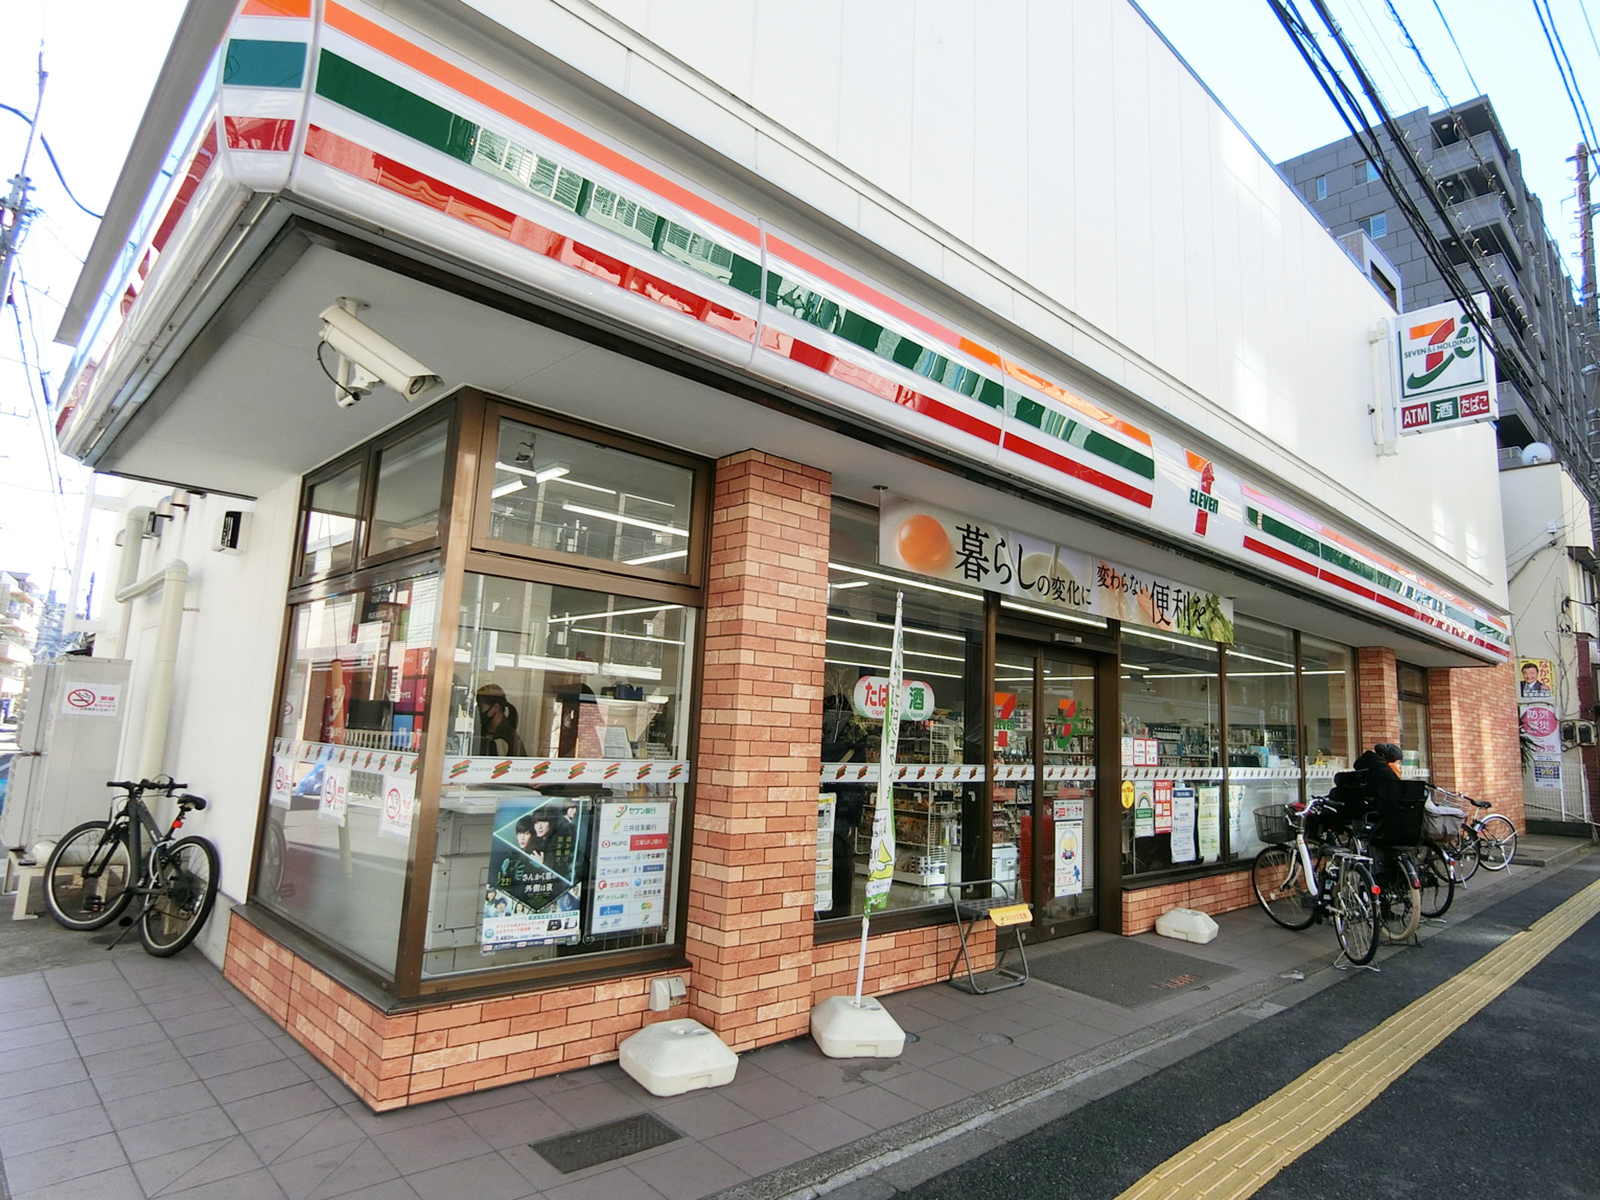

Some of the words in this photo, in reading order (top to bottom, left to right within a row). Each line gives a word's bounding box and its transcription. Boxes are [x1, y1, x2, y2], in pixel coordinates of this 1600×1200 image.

[1437, 337, 1477, 351] HOLDINGS
[1435, 401, 1454, 420] 酒
[1461, 394, 1489, 414] たばこ
[1403, 407, 1428, 425] ATM
[955, 523, 1092, 606] 暮らしの変化に
[1097, 565, 1207, 631] 変わらない便利を
[908, 686, 925, 711] 酒
[1527, 710, 1550, 719] 防災
[524, 883, 554, 893] 外側は夜
